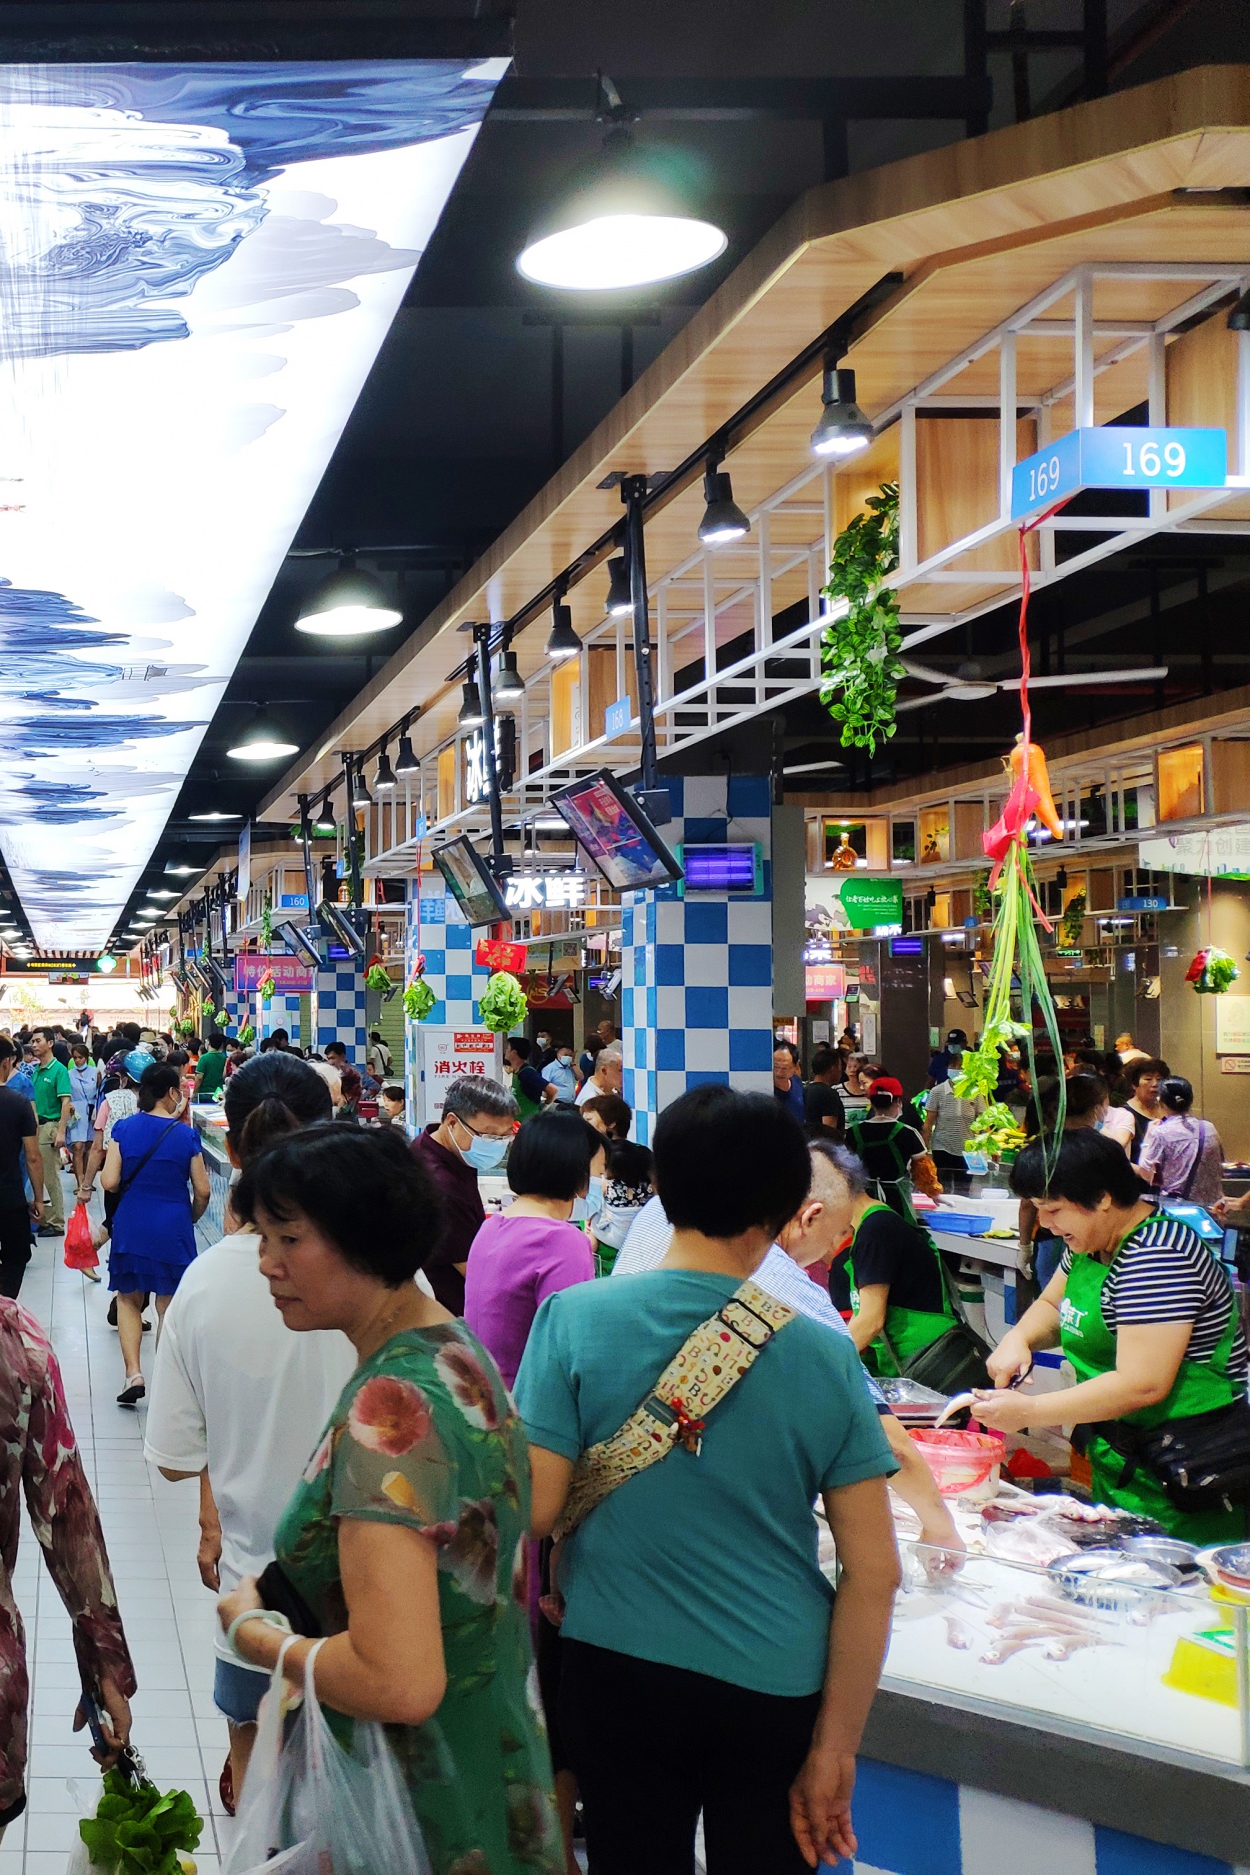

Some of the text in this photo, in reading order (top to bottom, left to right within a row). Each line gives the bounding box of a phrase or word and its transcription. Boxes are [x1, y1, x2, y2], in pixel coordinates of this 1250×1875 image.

[1122, 442, 1186, 477] 169
[1029, 456, 1060, 501] 169
[611, 708, 624, 731] 168
[505, 876, 585, 908] 冰鲜
[290, 897, 305, 906] 160
[1143, 899, 1159, 908] 130
[244, 964, 313, 978] 特价活动商
[434, 1060, 485, 1074] 消火栓
